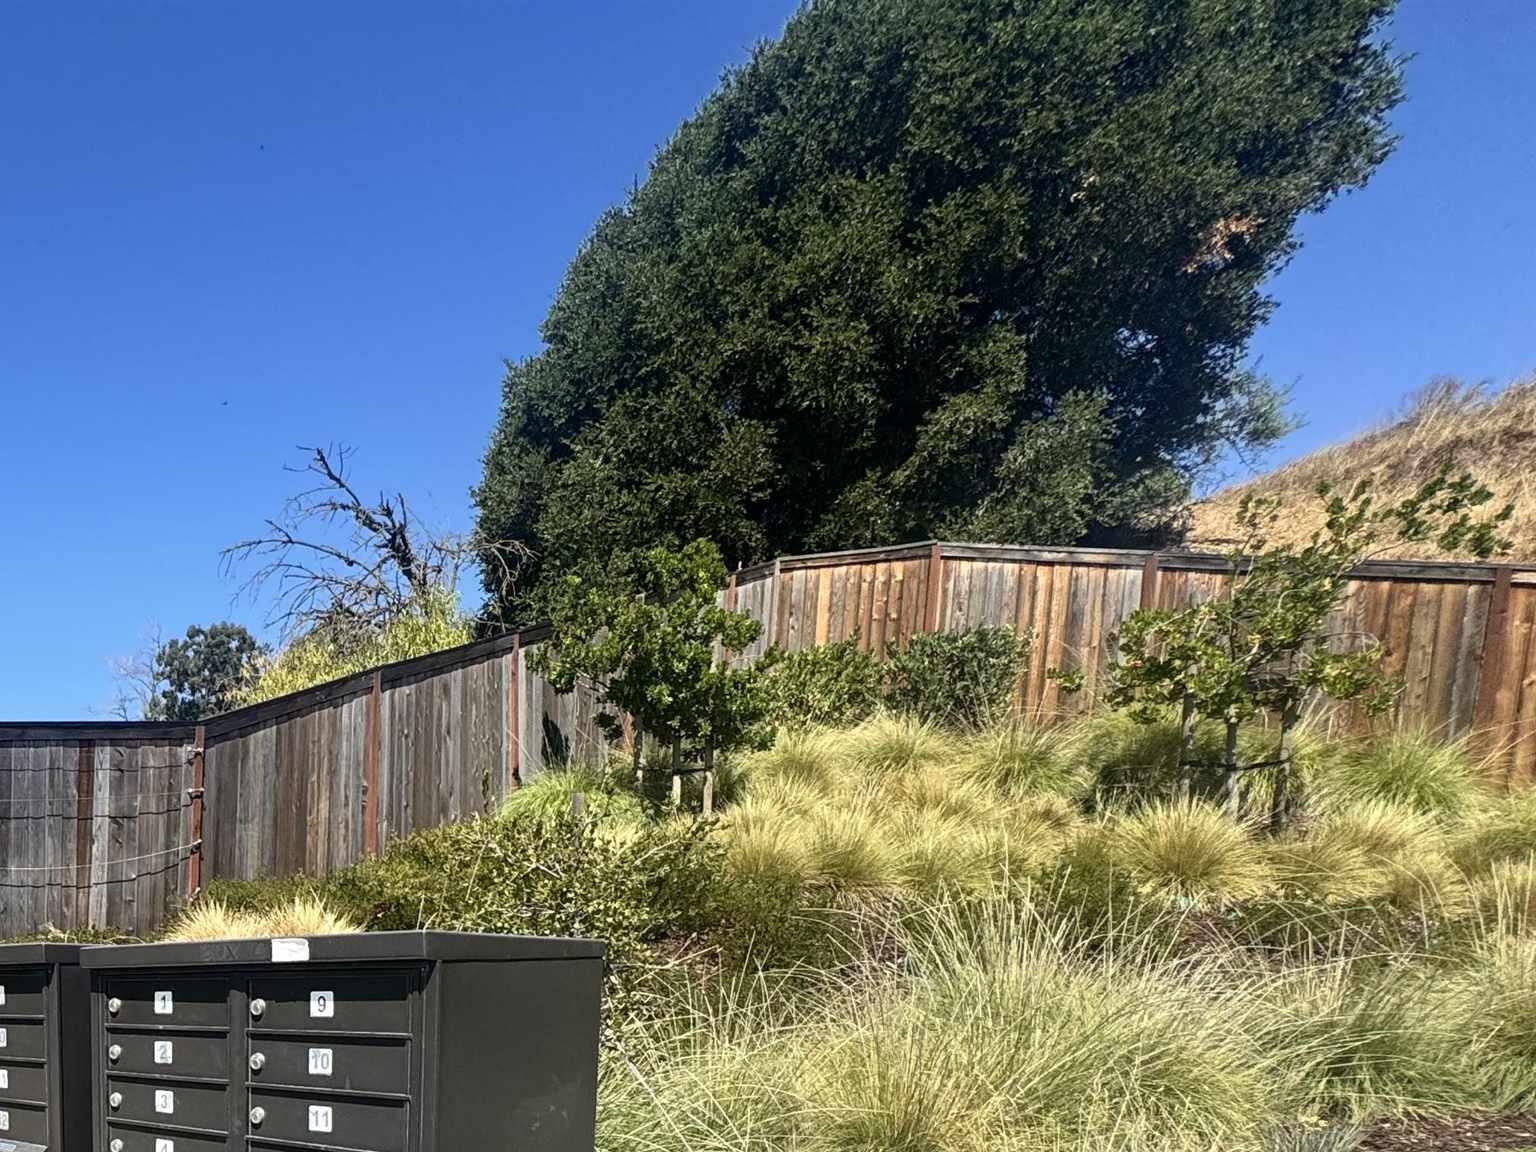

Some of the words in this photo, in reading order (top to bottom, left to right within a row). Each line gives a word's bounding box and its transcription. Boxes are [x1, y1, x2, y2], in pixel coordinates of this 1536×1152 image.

[317, 995, 326, 1012] 9
[312, 1053, 329, 1070] 10
[312, 1110, 329, 1128] 11
